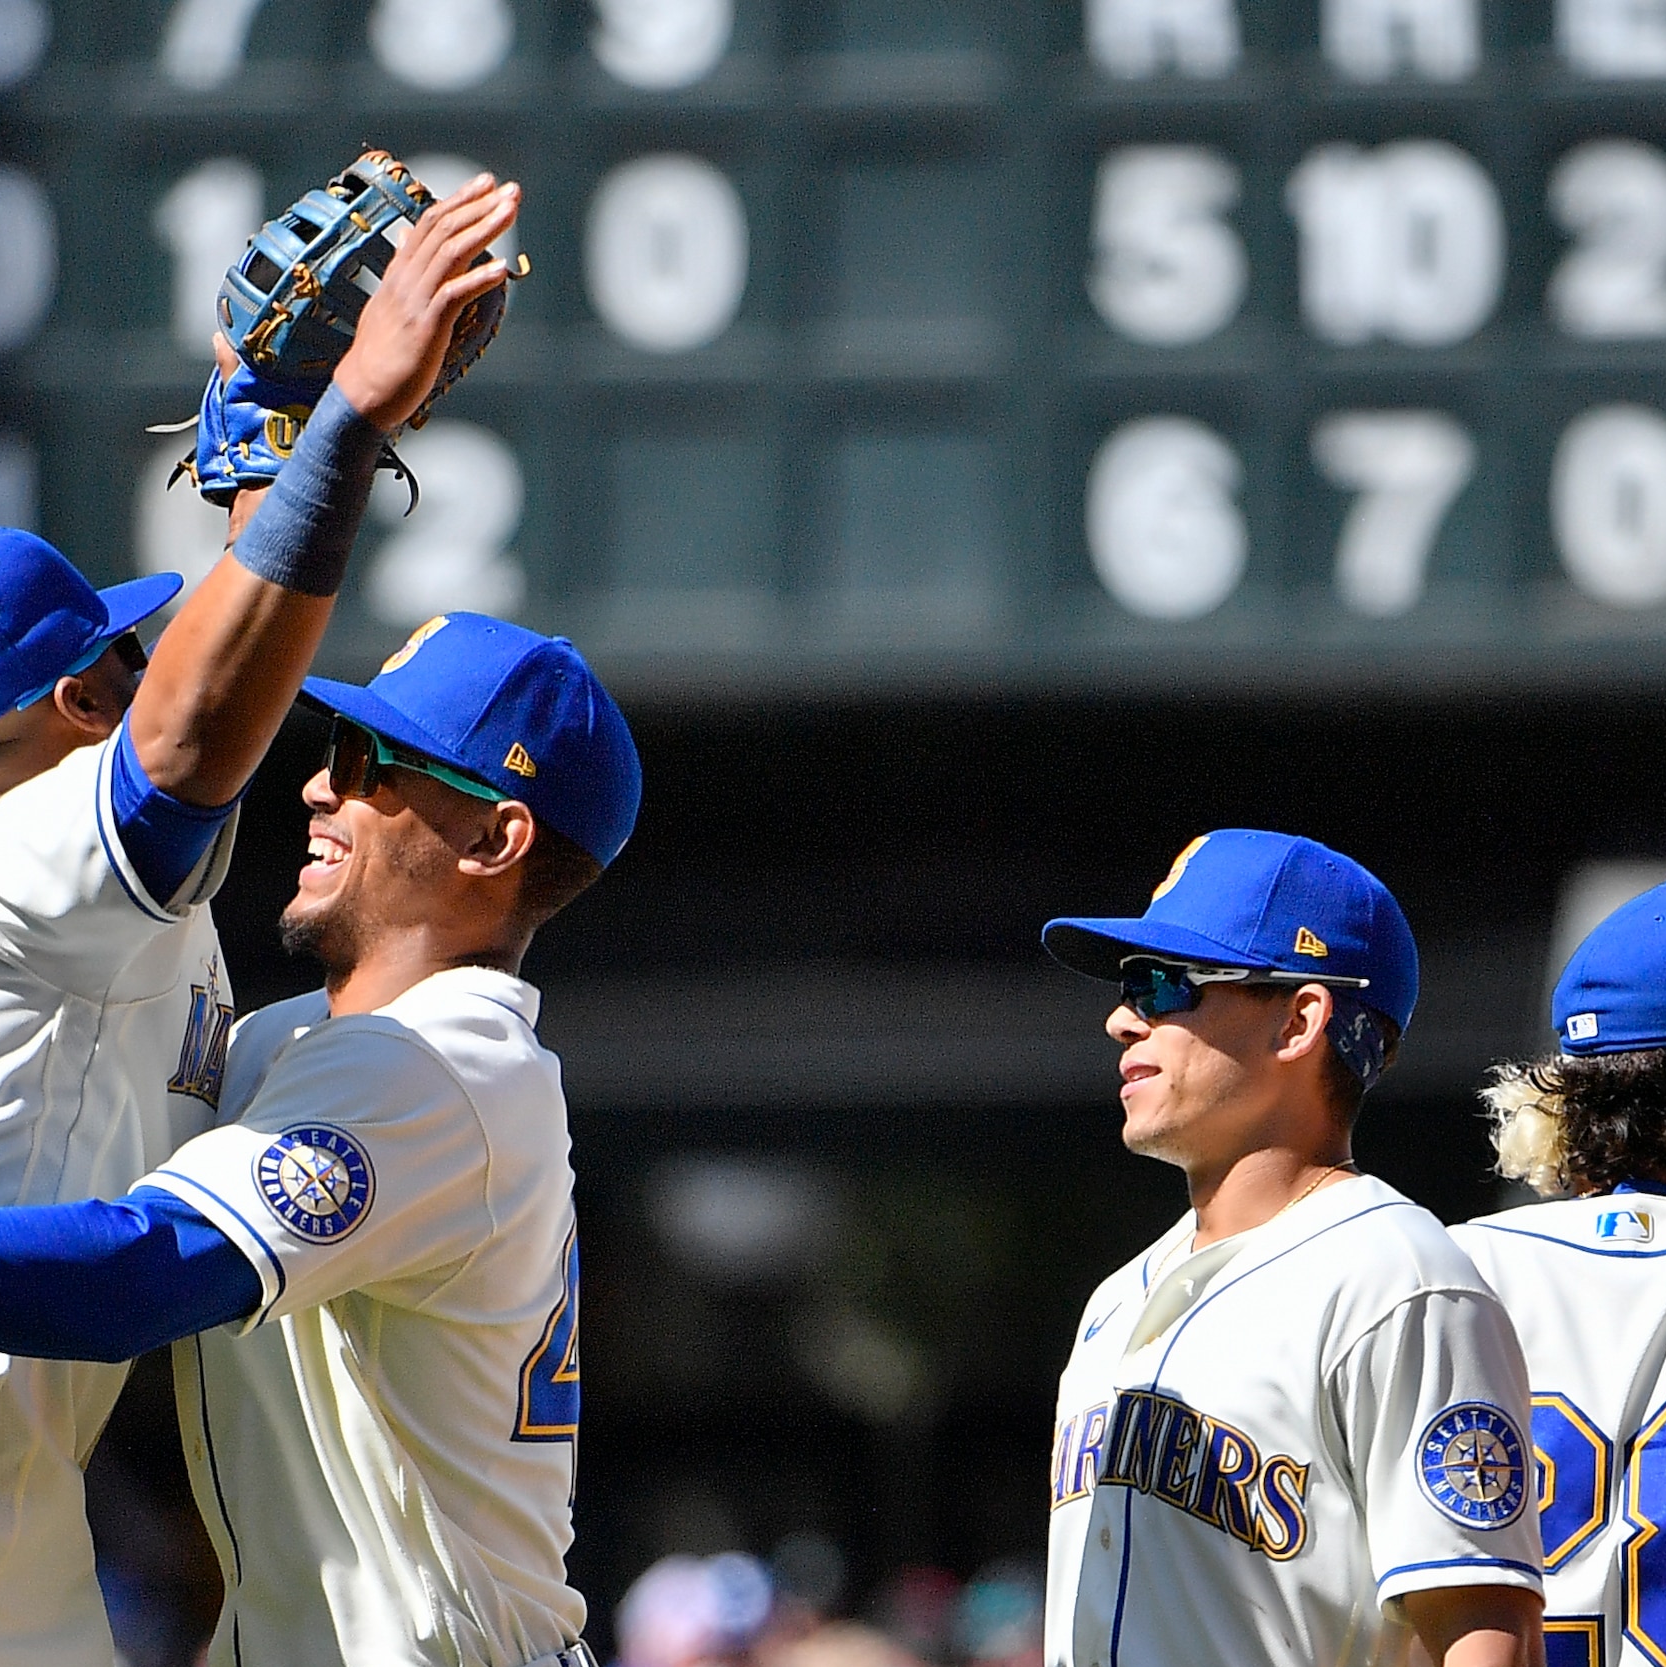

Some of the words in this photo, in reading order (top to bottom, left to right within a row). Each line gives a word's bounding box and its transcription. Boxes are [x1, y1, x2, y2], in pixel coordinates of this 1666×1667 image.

[583, 150, 749, 353] 0
[1086, 143, 1248, 347] 5
[1282, 137, 1506, 348] 10
[369, 420, 527, 628] 2
[1084, 413, 1248, 623] 6
[1309, 408, 1478, 620] 7
[290, 1130, 368, 1210] SEATTLE
[1426, 1410, 1519, 1454] SEATTLE
[1431, 1480, 1523, 1521] MARINERS
